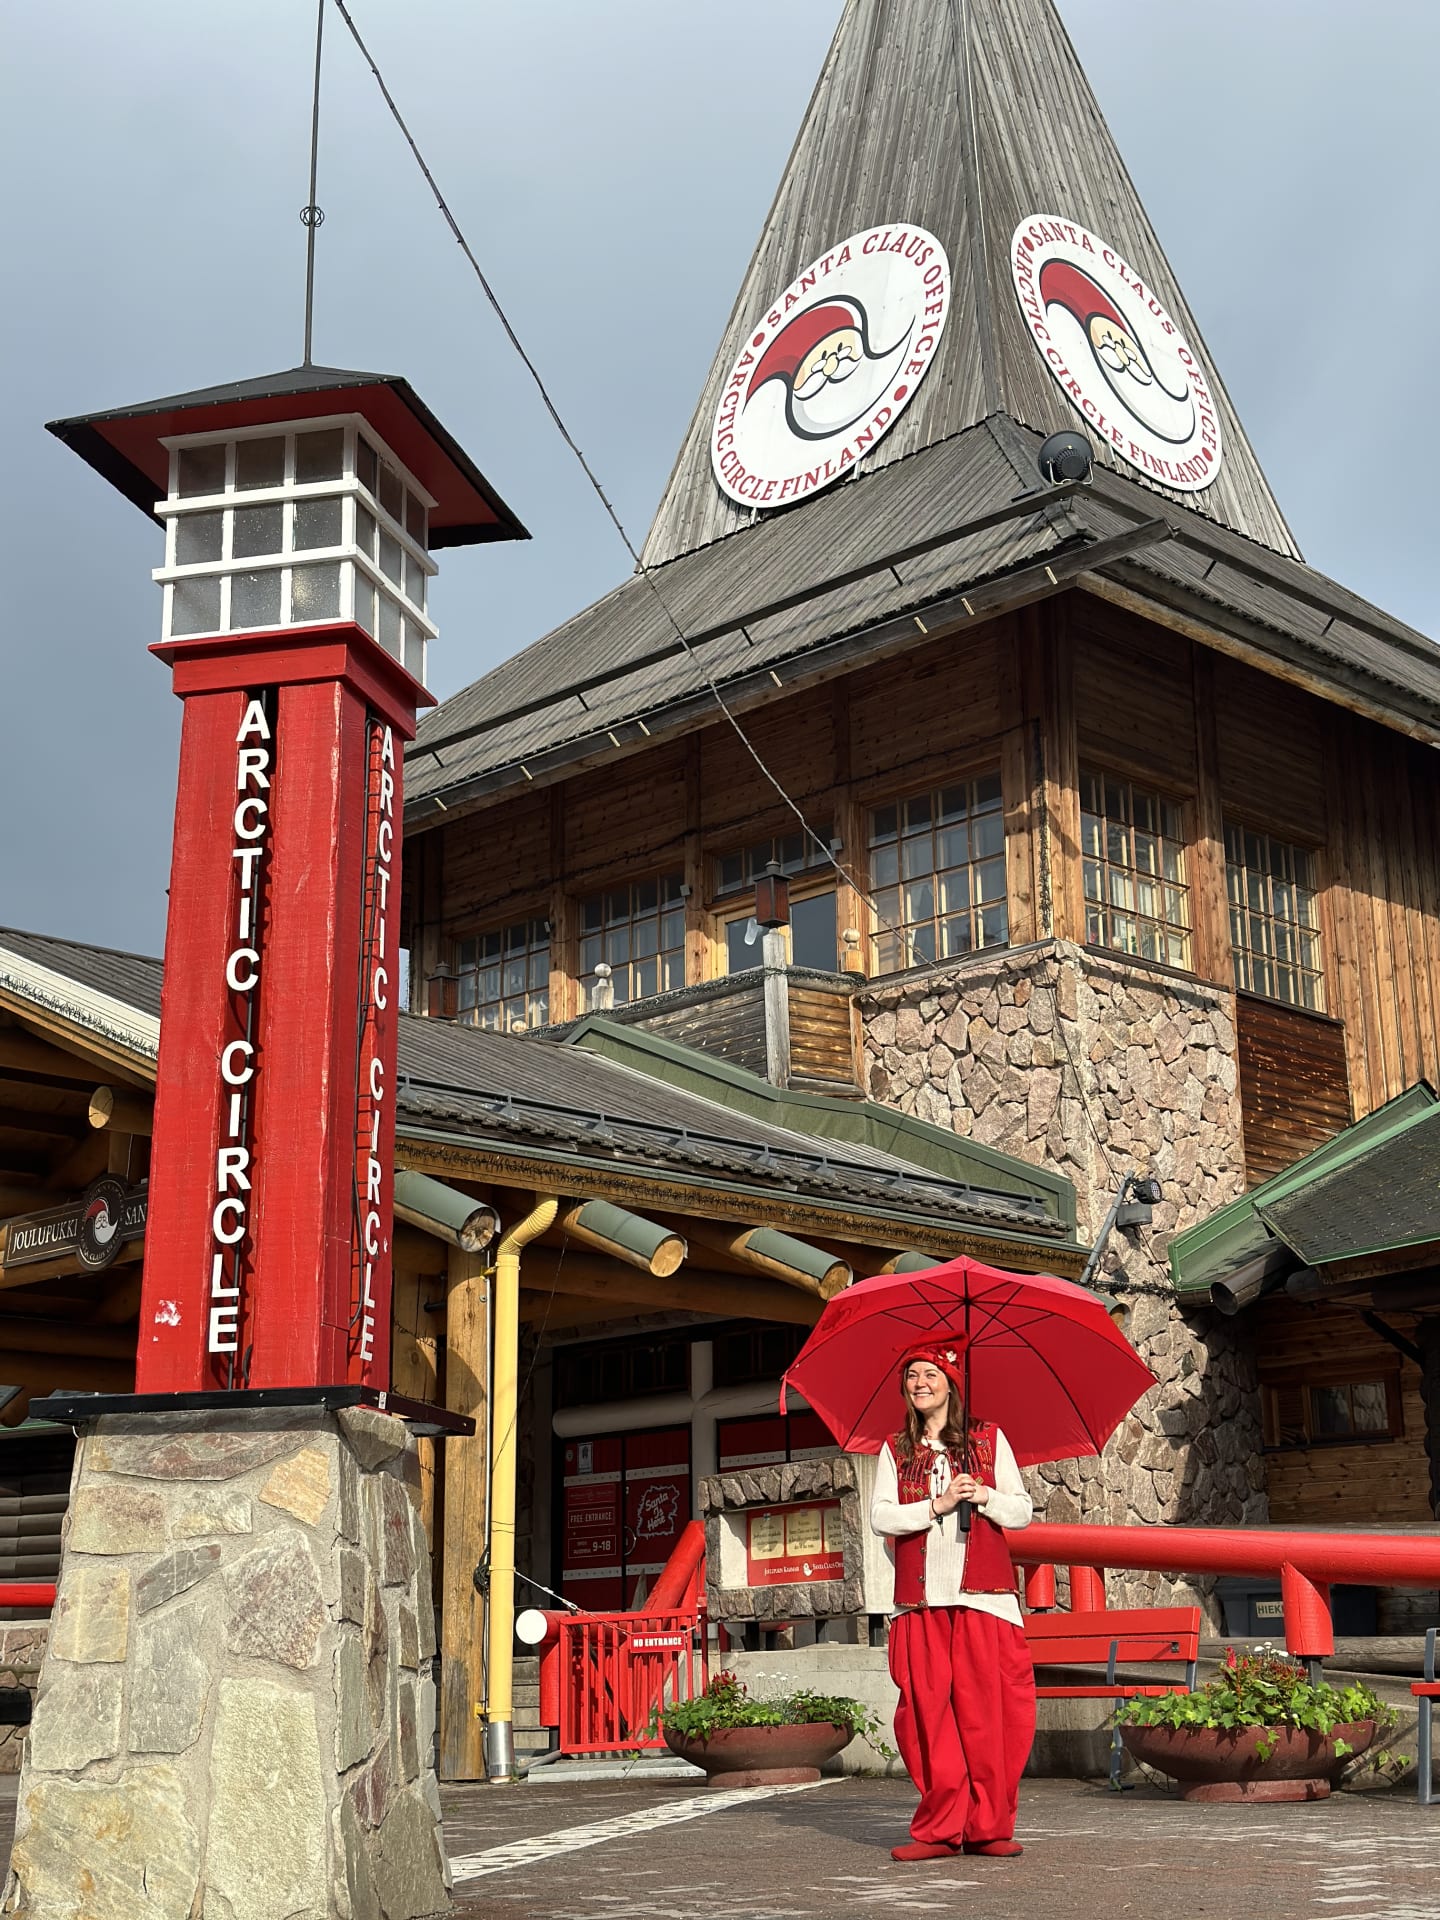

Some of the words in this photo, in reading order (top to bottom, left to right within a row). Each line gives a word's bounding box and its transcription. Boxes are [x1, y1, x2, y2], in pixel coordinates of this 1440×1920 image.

[767, 245, 852, 328] SANTA
[862, 231, 934, 267] CLAUS
[904, 264, 945, 376] OFFICE
[1016, 243, 1051, 341] ARCTIC
[1046, 347, 1123, 449] CIRCLE
[1127, 442, 1209, 483] FINLAND
[1028, 222, 1095, 255] SANTA
[1103, 249, 1176, 335] CLAUS
[1177, 347, 1217, 451] OFFICE
[717, 350, 755, 452] ARCTIC
[777, 406, 892, 499] FINLAND
[719, 450, 778, 500] CIRCLE
[225, 700, 271, 991] ARCTIC
[374, 725, 395, 1010] ARCTIC
[12, 1219, 78, 1254] JOULUPUKKI
[208, 1040, 254, 1352] CIRCLE
[360, 1057, 384, 1361] CIRCLE
[570, 1514, 584, 1523] FREE
[585, 1511, 612, 1522] ENTRANCE
[592, 1540, 611, 1552] 9-18
[633, 1638, 643, 1648] NO
[644, 1636, 682, 1647] ENTRANCE
